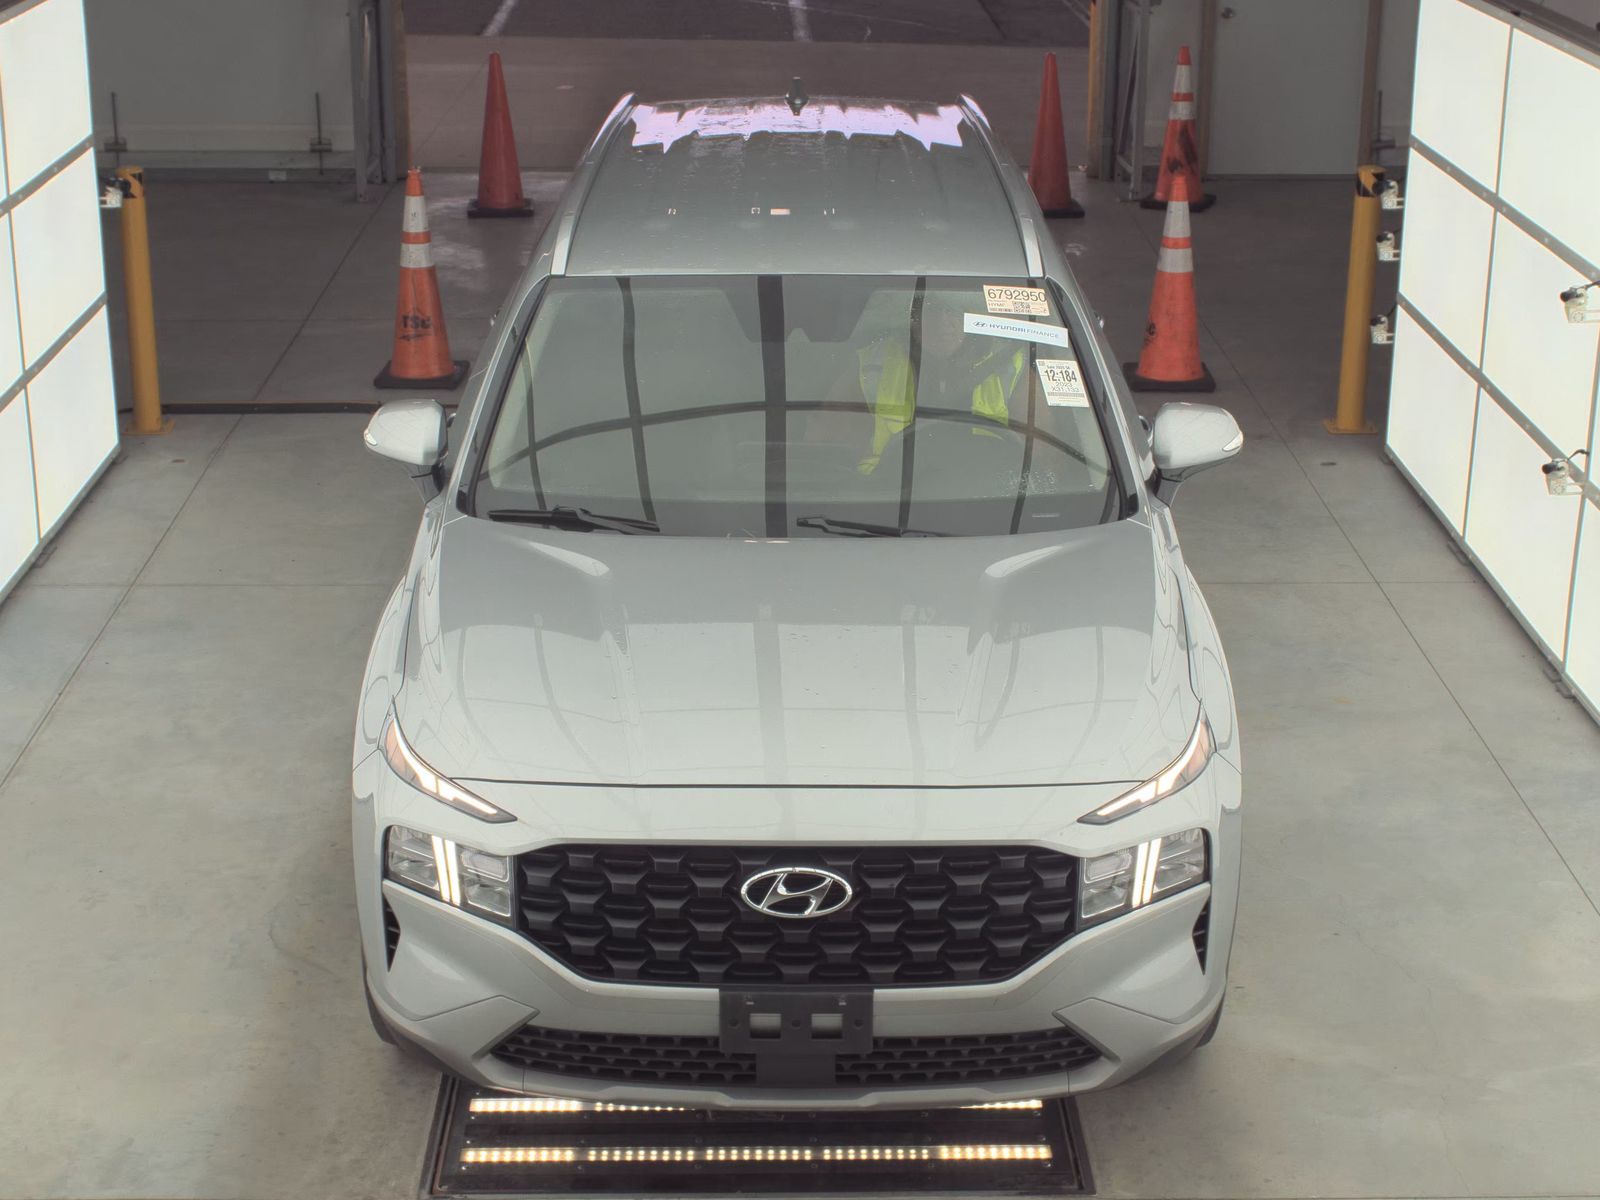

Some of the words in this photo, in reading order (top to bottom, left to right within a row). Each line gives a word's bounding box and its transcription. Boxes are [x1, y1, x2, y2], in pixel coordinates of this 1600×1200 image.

[987, 288, 1047, 302] 6792950
[989, 323, 1026, 333] HYUNDAI
[1026, 328, 1060, 338] FINANCE
[1044, 369, 1077, 382] 12:184
